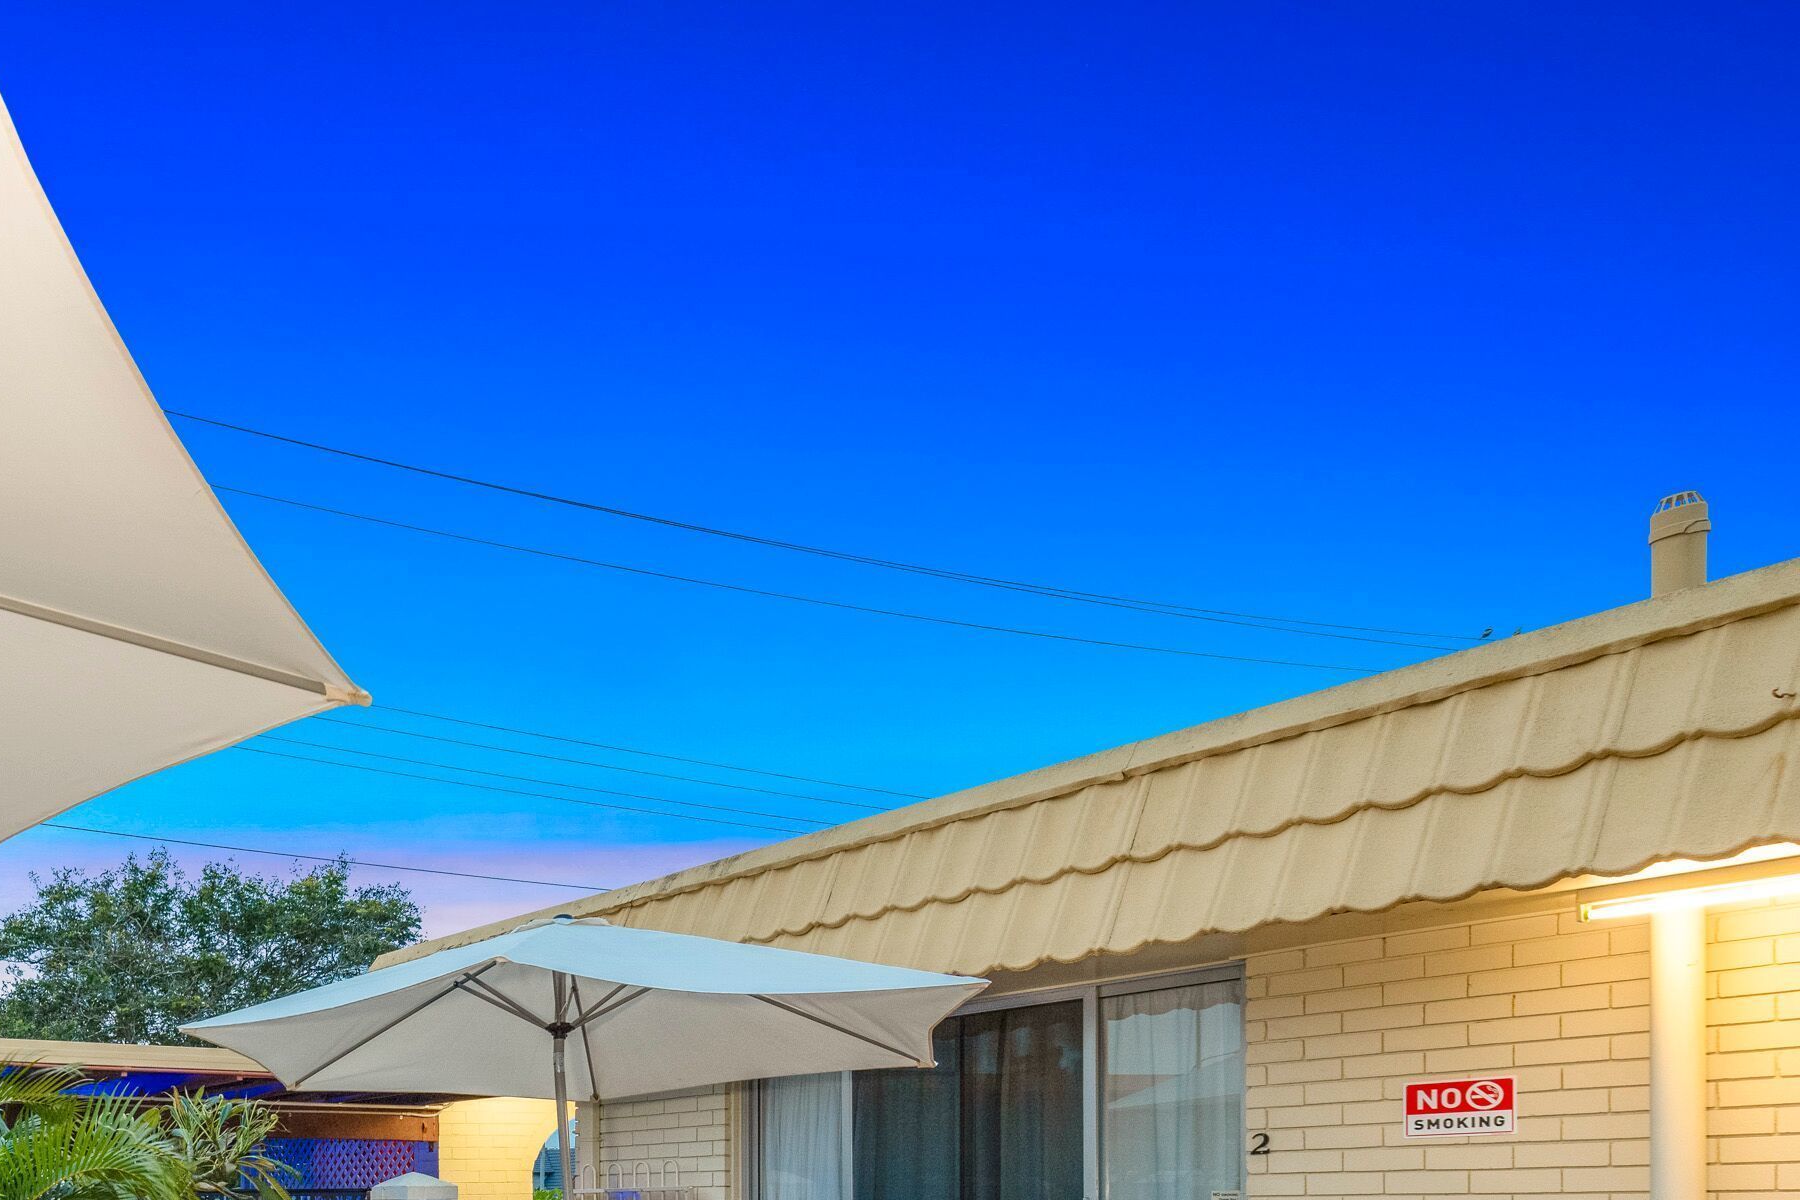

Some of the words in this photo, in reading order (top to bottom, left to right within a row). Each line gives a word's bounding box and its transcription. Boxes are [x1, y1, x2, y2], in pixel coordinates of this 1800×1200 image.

[1416, 1087, 1462, 1111] NO
[1414, 1116, 1505, 1131] SMOKING
[1250, 1132, 1271, 1155] 2
